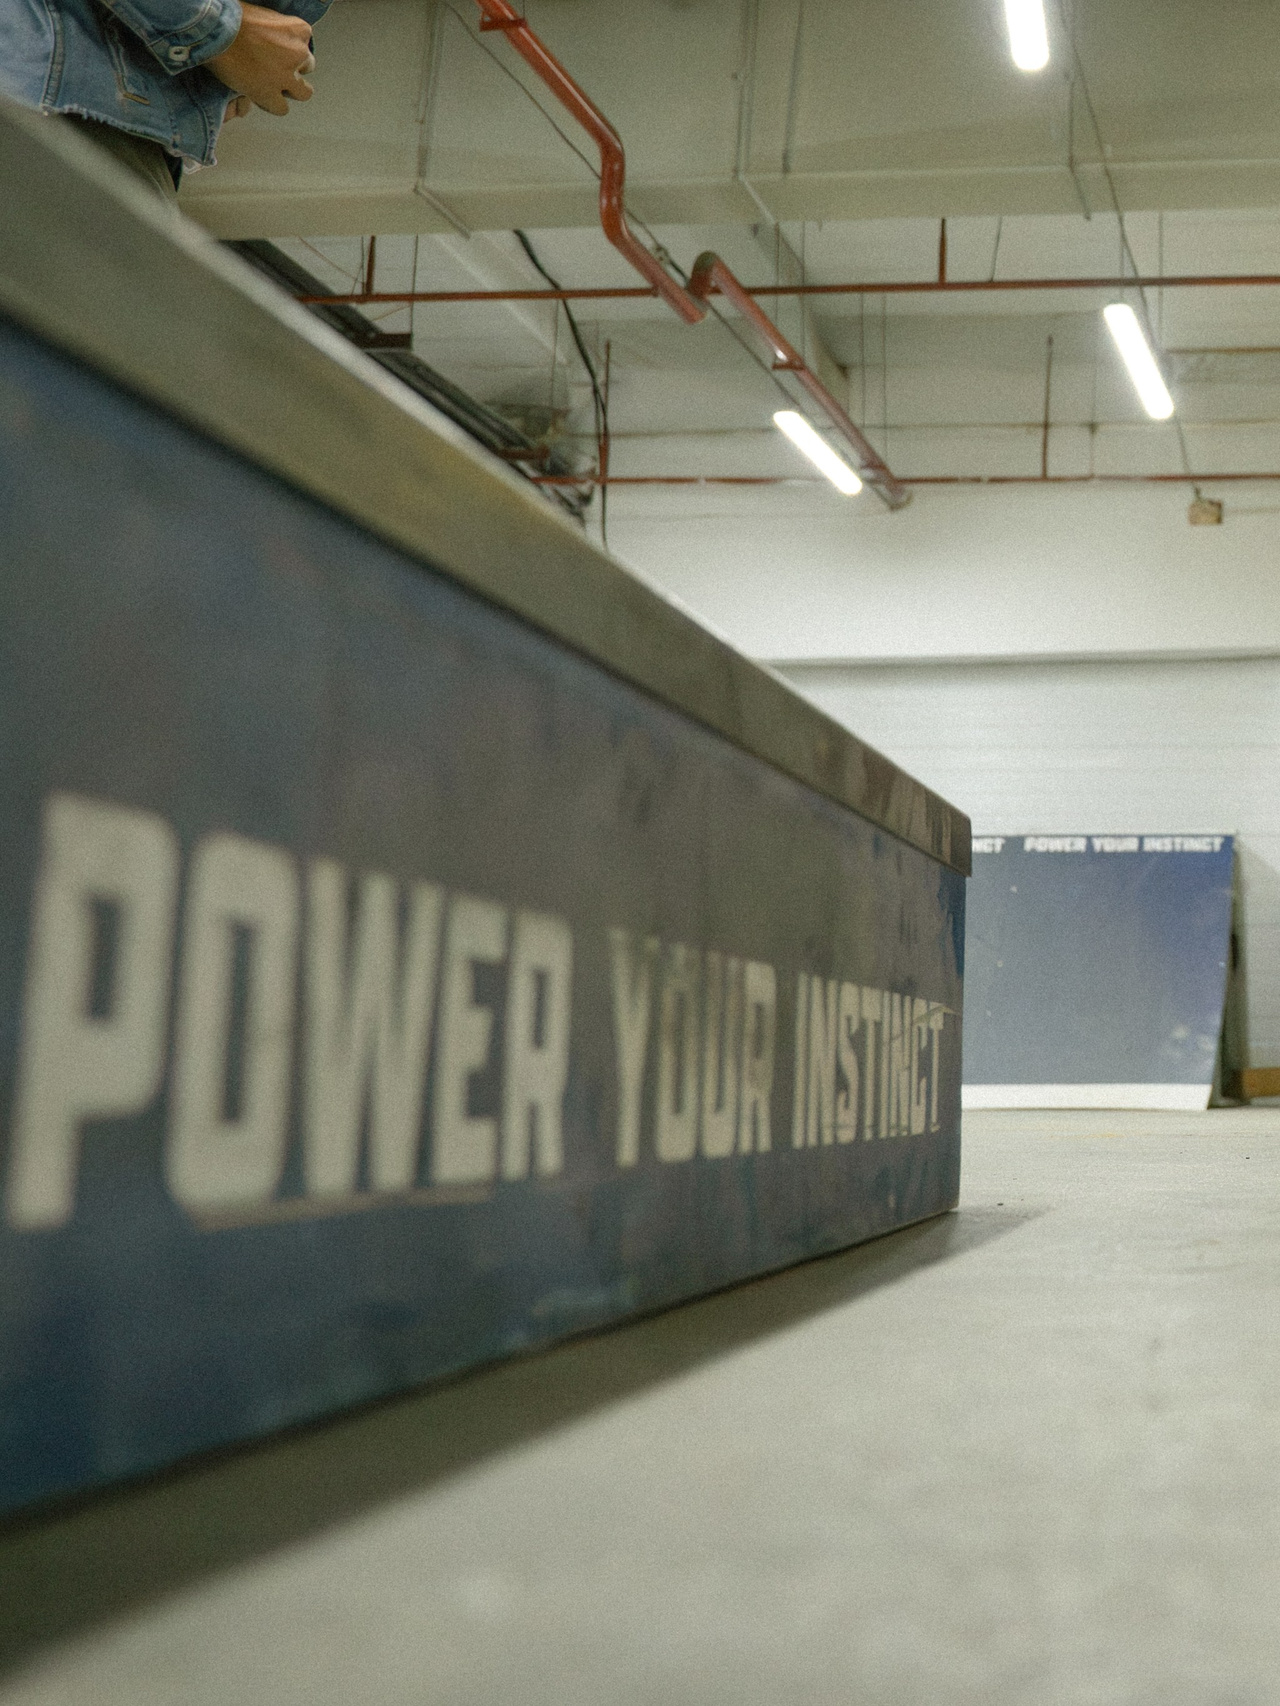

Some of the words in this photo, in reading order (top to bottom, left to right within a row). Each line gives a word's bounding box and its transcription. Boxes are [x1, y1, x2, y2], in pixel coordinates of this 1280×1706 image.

[4, 790, 574, 1232] POWER
[608, 926, 777, 1167] YOUR
[791, 972, 945, 1150] INSTINCT
